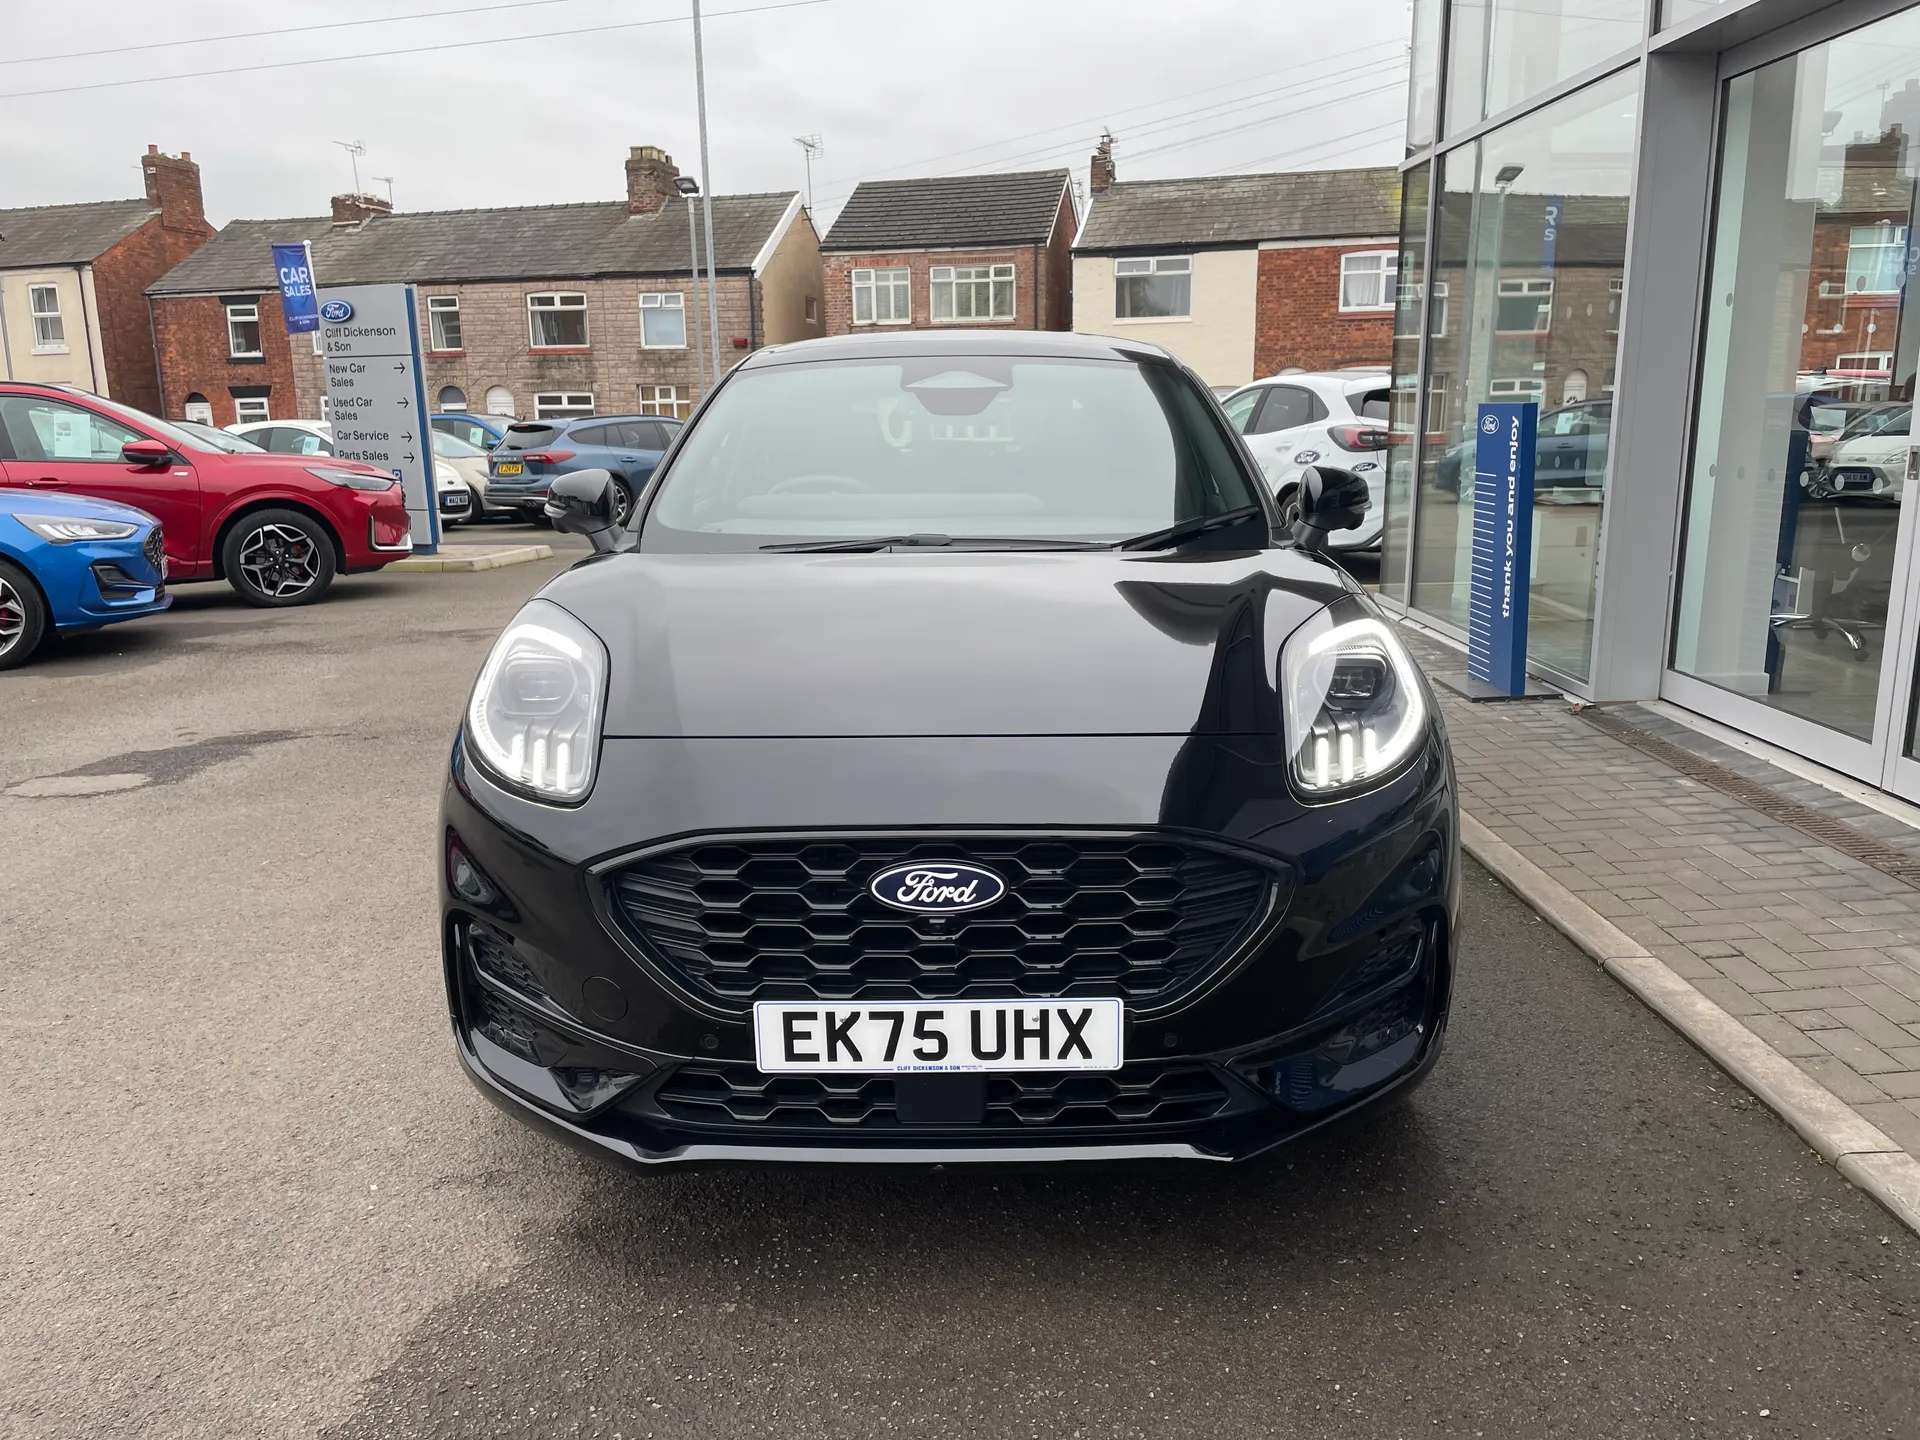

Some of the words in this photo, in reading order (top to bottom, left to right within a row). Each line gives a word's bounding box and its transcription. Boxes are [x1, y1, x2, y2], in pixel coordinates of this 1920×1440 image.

[280, 267, 309, 285] CAR
[284, 285, 312, 298] SALES
[325, 303, 345, 319] Ford
[325, 327, 342, 339] Cliff
[343, 326, 397, 338] Dickenson
[327, 342, 333, 352] &
[334, 341, 352, 352] Son
[329, 364, 348, 374] New
[349, 363, 366, 374] Car
[331, 377, 354, 388] Sales
[333, 397, 355, 407] Used
[356, 397, 373, 407] Car
[334, 410, 358, 421] Sales
[337, 430, 352, 441] Car
[353, 430, 390, 441] Service
[1509, 415, 1520, 473] enjoy
[339, 450, 361, 460] Parts
[362, 449, 389, 461] Sales
[1507, 476, 1516, 516] and
[1505, 519, 1514, 557] you
[1502, 560, 1512, 618] thank
[896, 870, 980, 904] Ford
[782, 1010, 950, 1063] EK75
[970, 1008, 1094, 1061] UHX
